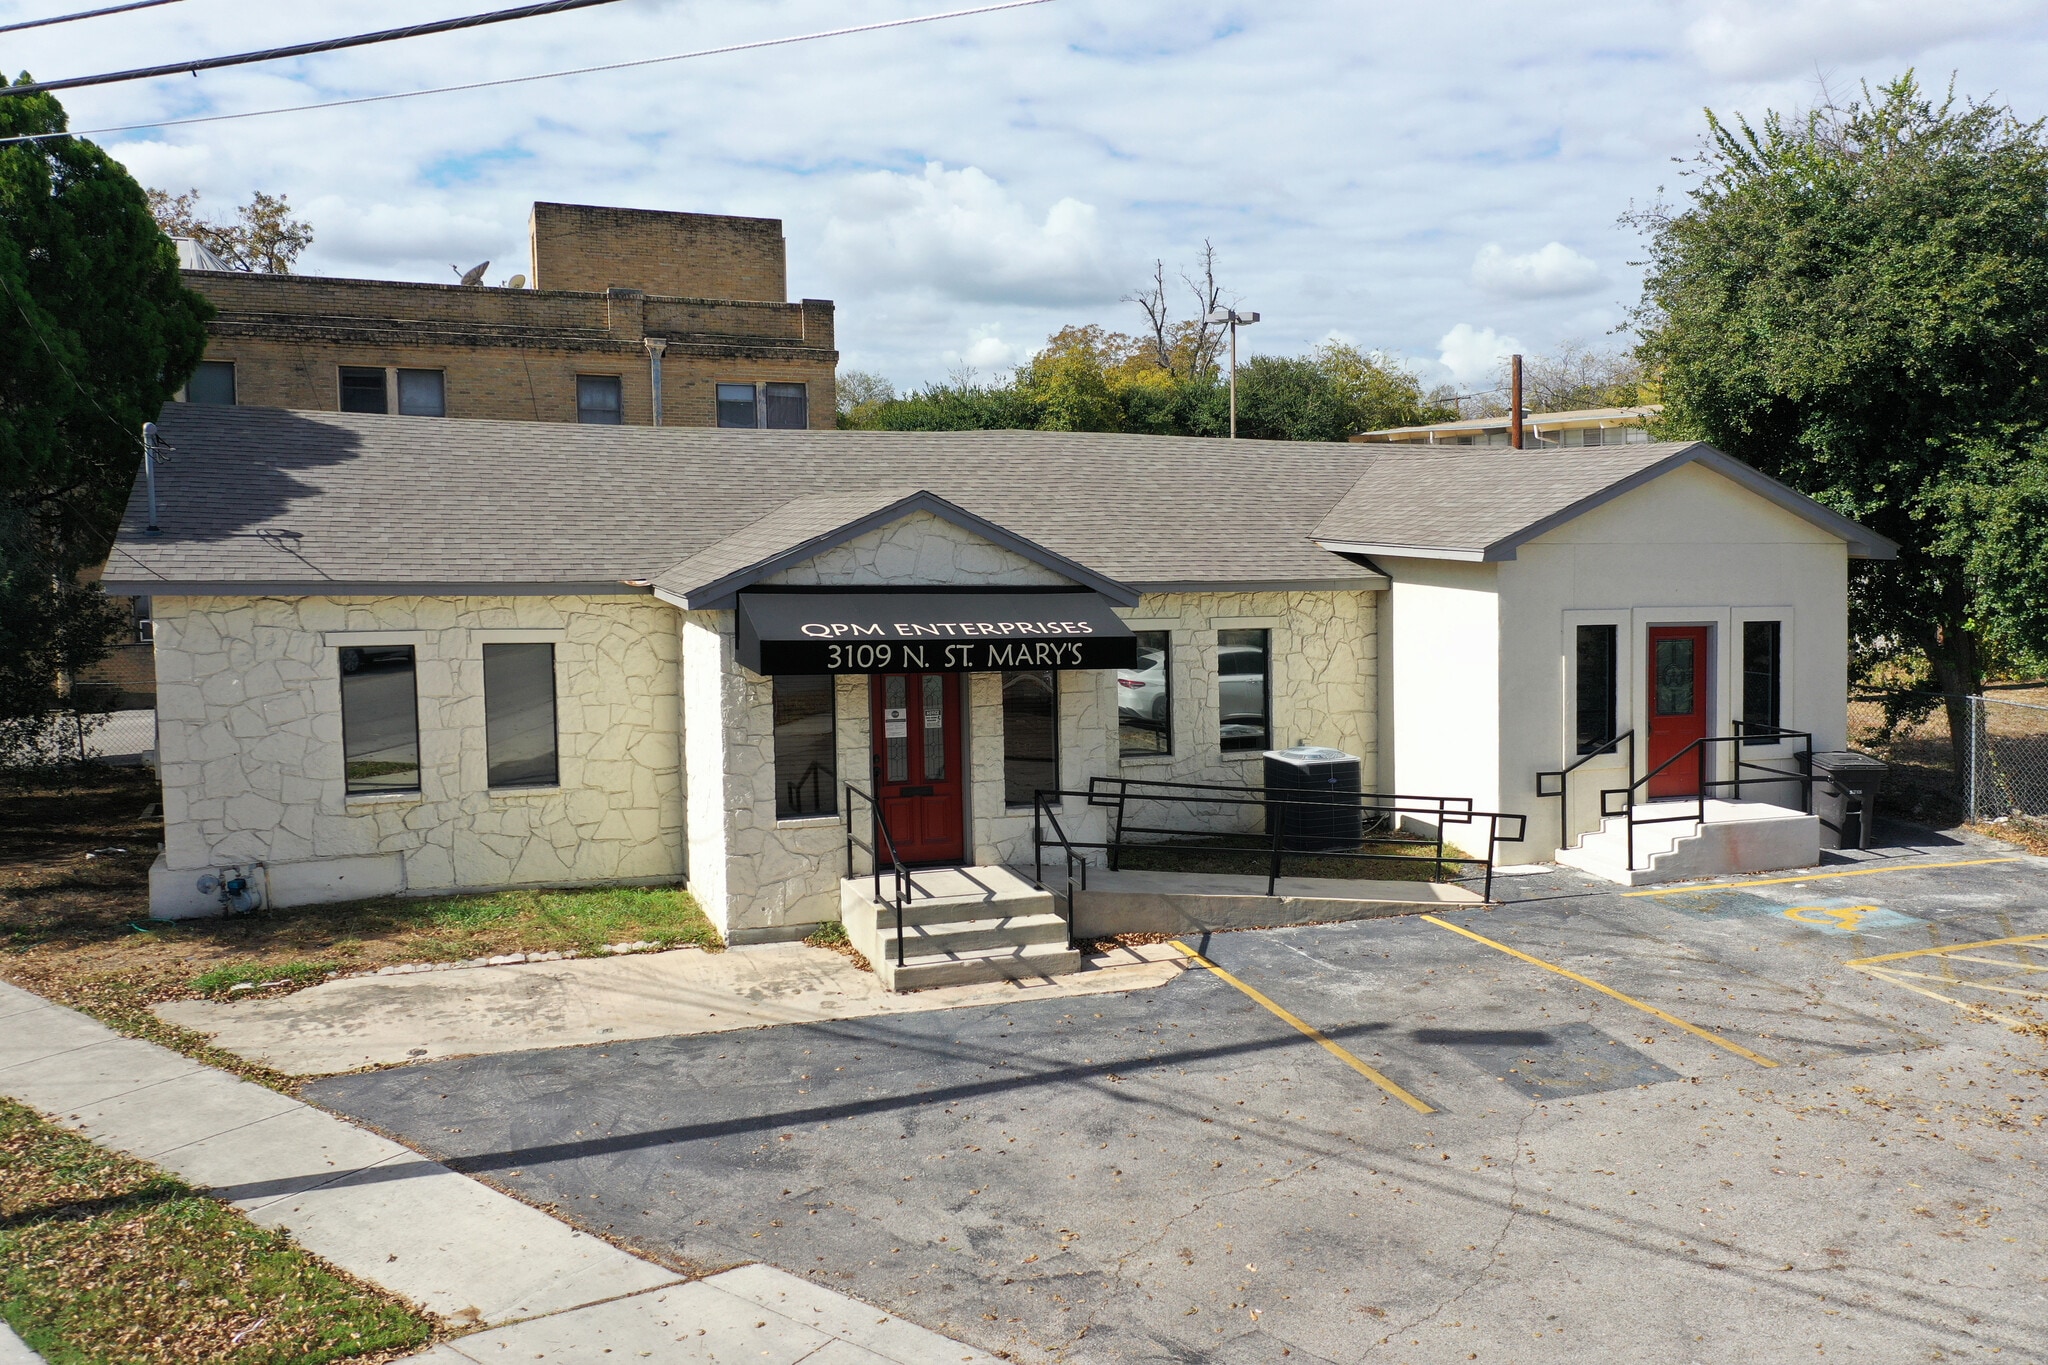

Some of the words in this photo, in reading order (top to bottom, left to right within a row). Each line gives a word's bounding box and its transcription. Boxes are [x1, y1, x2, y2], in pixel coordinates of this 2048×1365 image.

[801, 623, 886, 638] QPM
[894, 621, 1093, 636] ENTERPRISES
[827, 644, 892, 668] 3109
[903, 645, 930, 668] N.
[945, 644, 974, 668] ST.
[987, 642, 1083, 667] MARY'S
